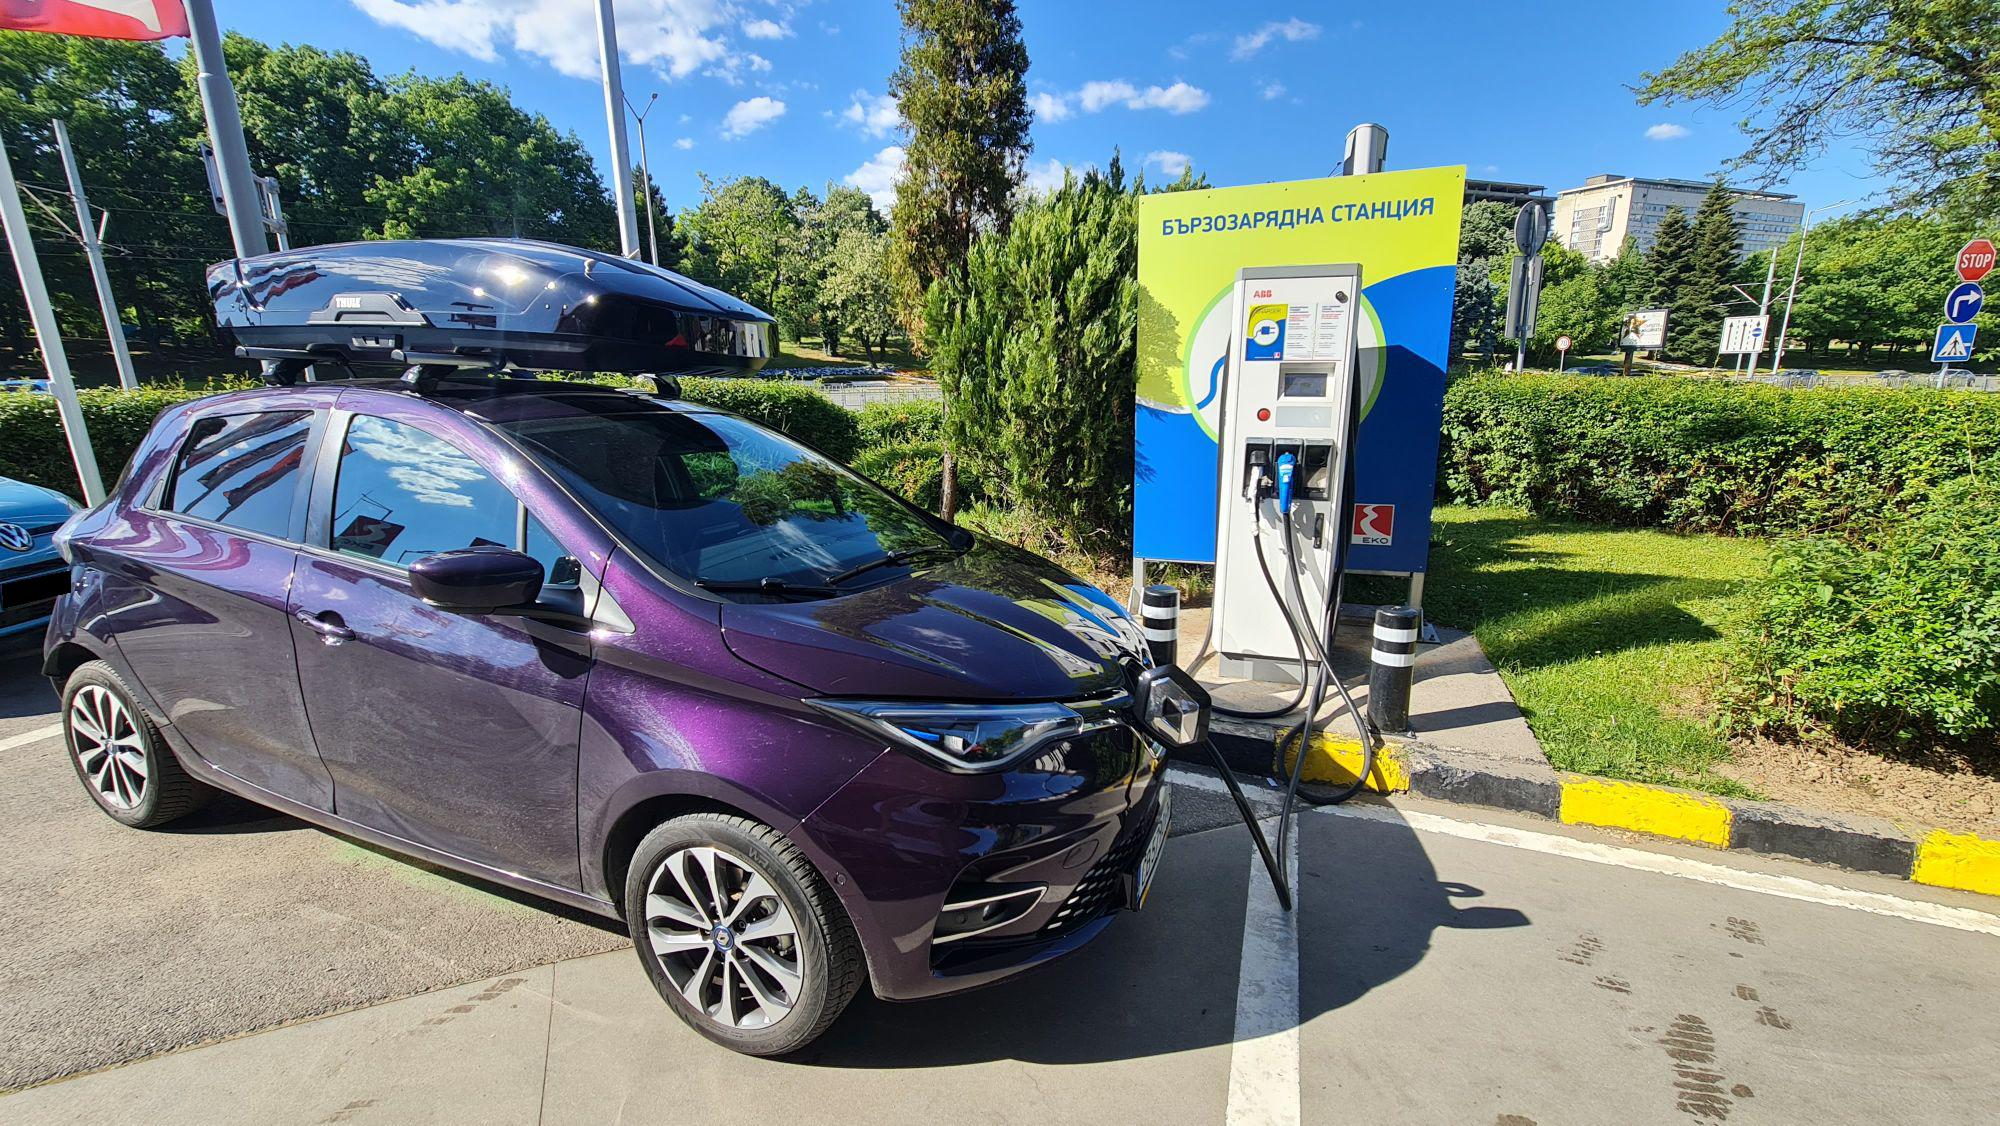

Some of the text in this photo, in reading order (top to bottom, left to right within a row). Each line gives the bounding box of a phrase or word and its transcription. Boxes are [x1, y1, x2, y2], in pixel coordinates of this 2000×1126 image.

[1161, 197, 1434, 236] БЪРЗОЗАРЯДНА СТАНЦИЯ
[1960, 253, 1992, 269] STOP
[1253, 290, 1272, 298] ABB
[335, 297, 361, 308] THULE
[1362, 537, 1389, 545] EKO
